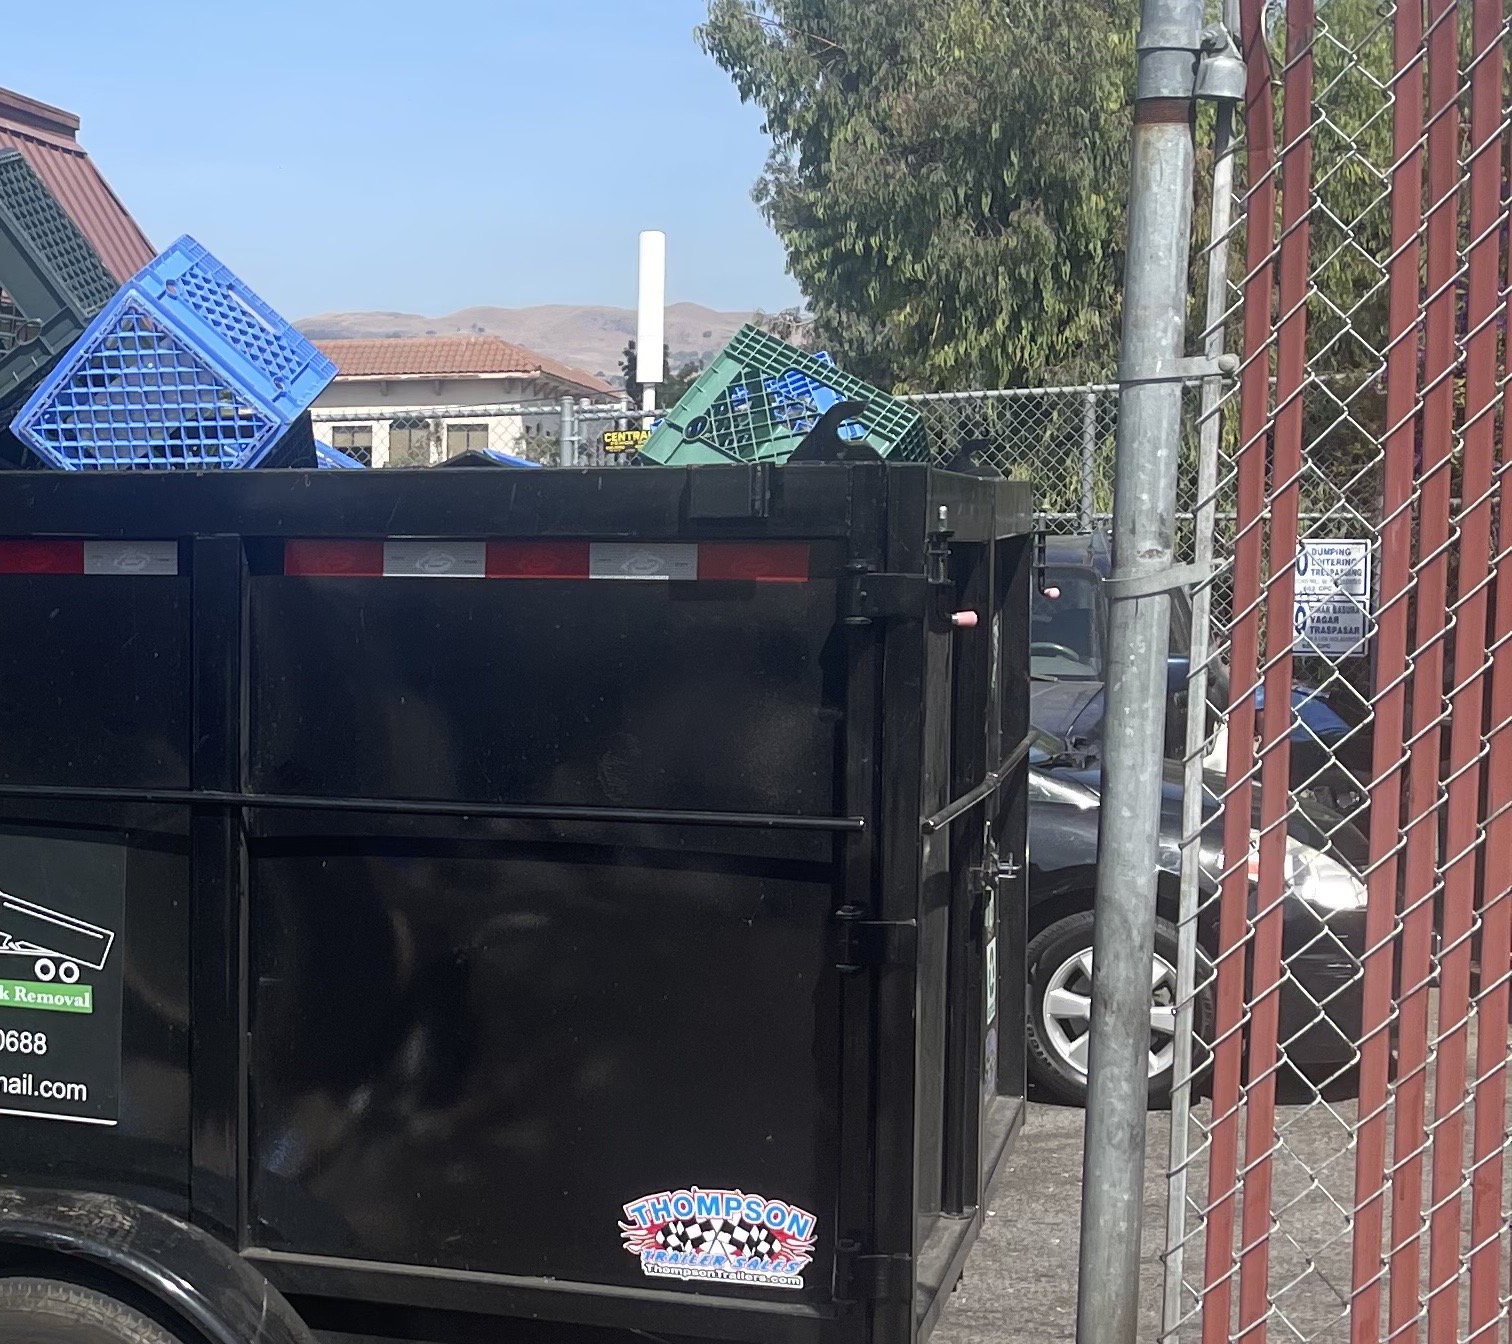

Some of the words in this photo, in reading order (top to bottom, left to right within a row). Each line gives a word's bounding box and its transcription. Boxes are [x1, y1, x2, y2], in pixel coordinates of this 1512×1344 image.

[1311, 548, 1351, 556] DUMPING
[1309, 626, 1360, 634] TRASPASAR
[14, 986, 91, 1009] Removal
[630, 1195, 810, 1240] THOMPSON
[643, 1250, 726, 1268] TRAILER
[732, 1256, 801, 1274] SALES
[644, 1263, 802, 1287] ThompsonTrailers.com
